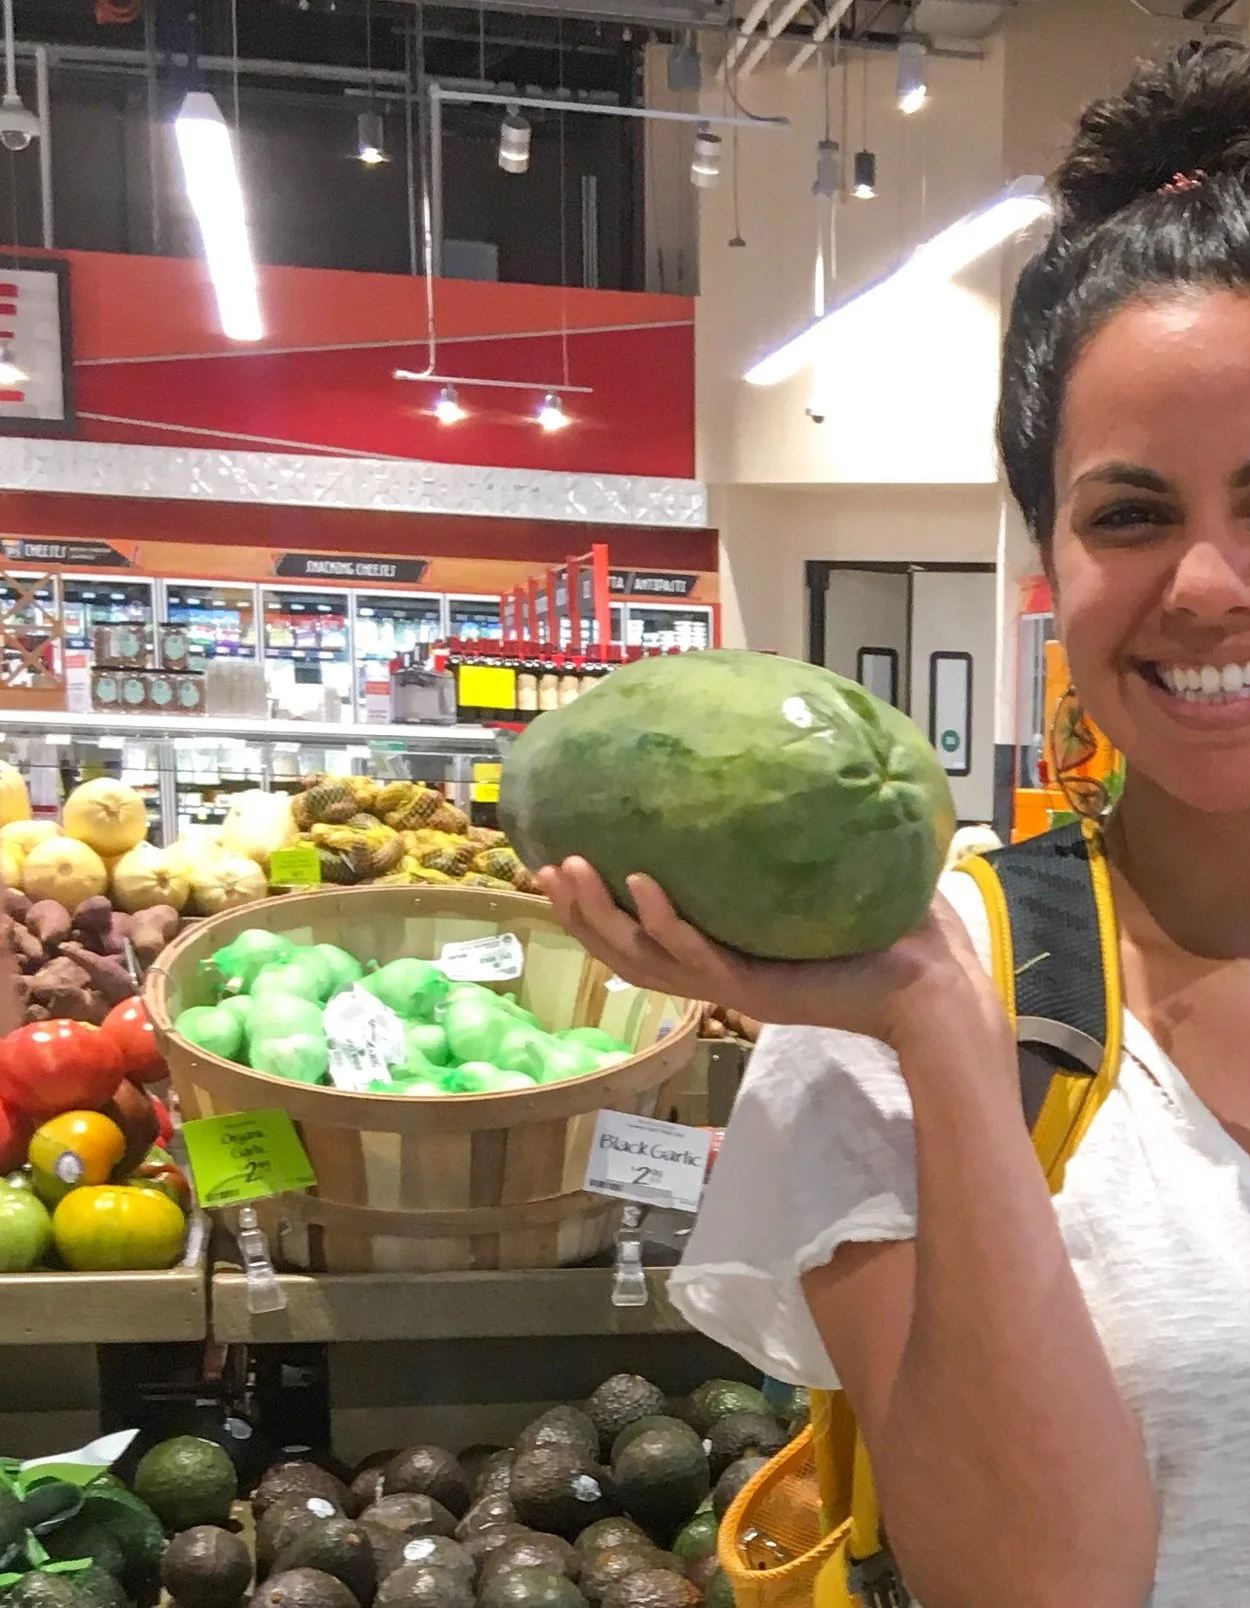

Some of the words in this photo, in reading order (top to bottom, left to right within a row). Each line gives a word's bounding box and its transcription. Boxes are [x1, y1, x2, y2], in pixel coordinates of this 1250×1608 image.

[355, 562, 397, 577] CHEESES
[600, 1134, 648, 1156] Black
[650, 1143, 702, 1167] Garlic
